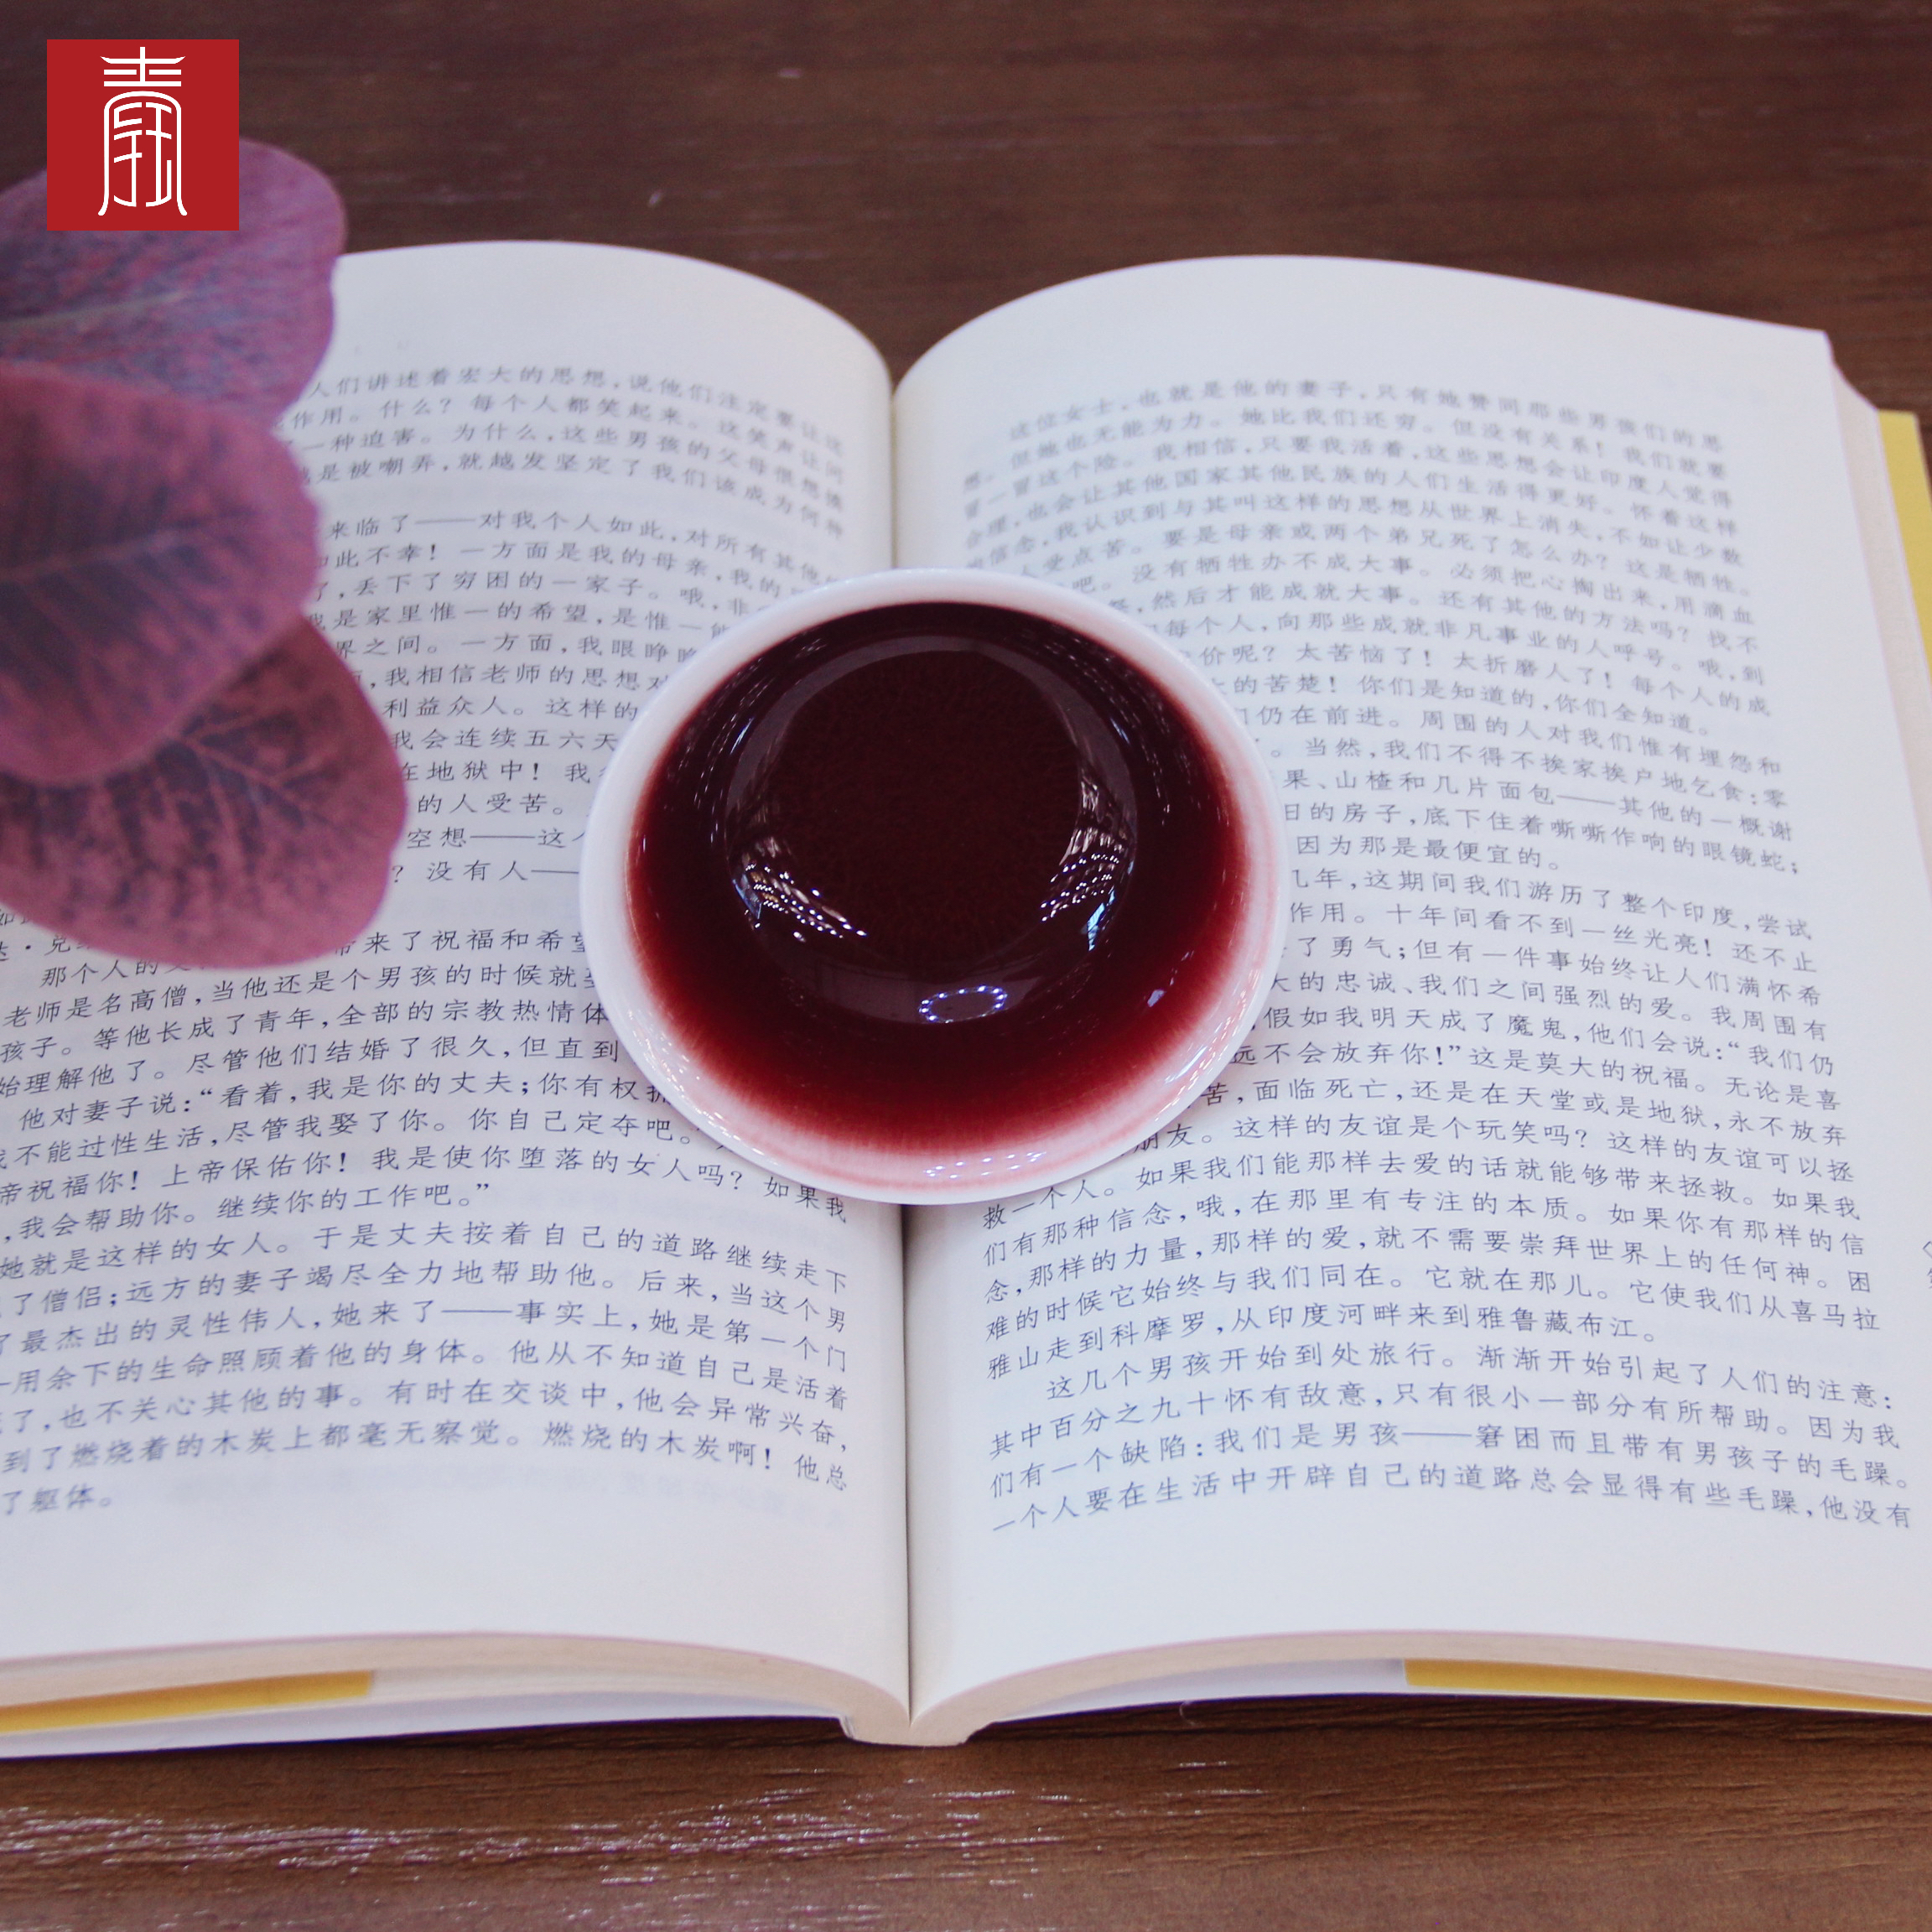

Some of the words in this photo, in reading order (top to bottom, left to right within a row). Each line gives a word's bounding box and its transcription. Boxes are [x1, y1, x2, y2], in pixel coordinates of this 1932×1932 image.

[401, 760, 606, 784] 在地狱中！我
